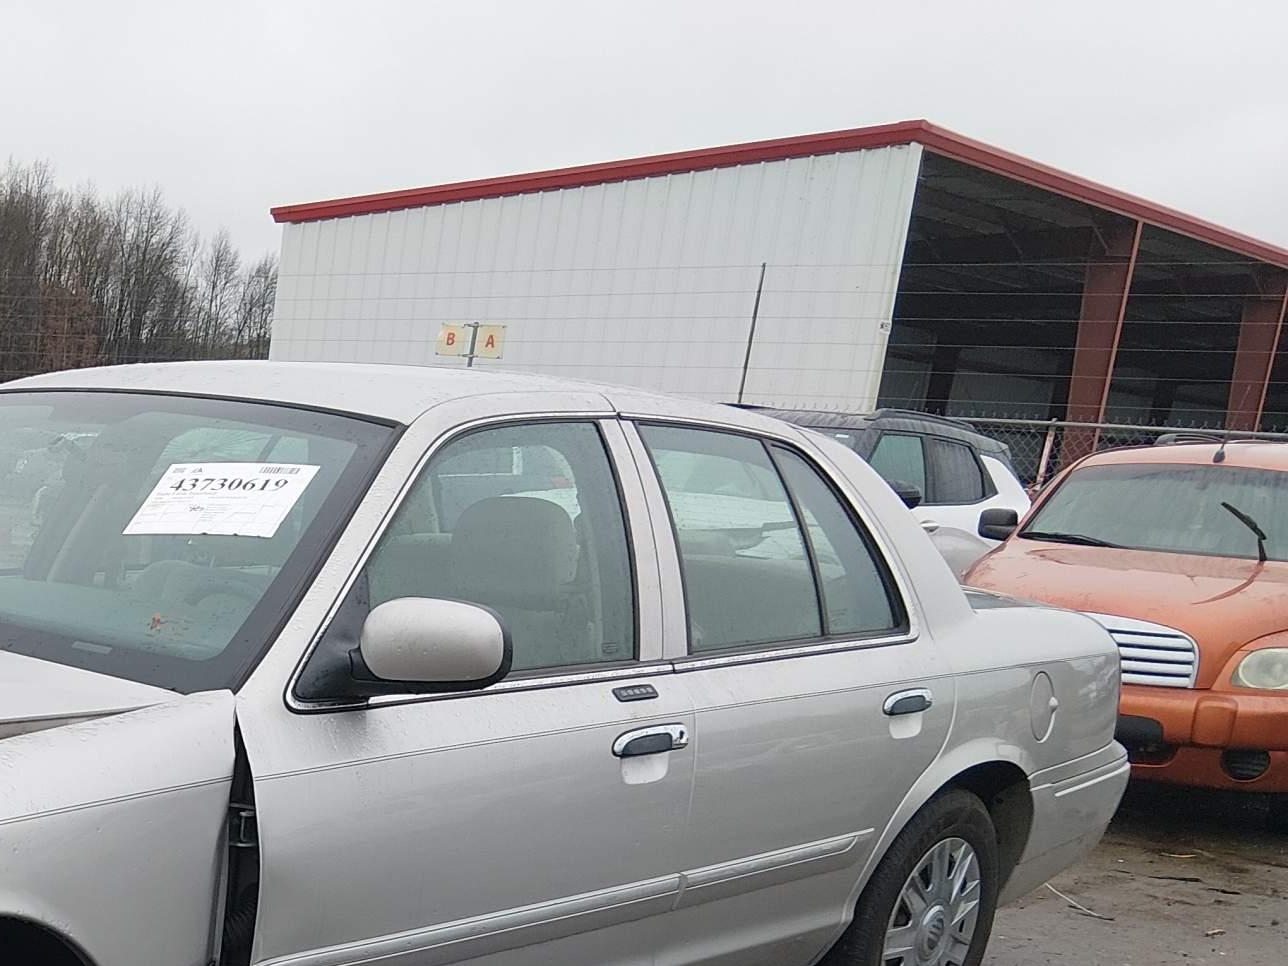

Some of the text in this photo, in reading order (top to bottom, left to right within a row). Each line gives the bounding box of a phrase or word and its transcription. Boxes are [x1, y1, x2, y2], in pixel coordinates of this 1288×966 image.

[445, 332, 456, 346] B
[485, 334, 495, 348] A
[169, 477, 289, 492] 43730619
